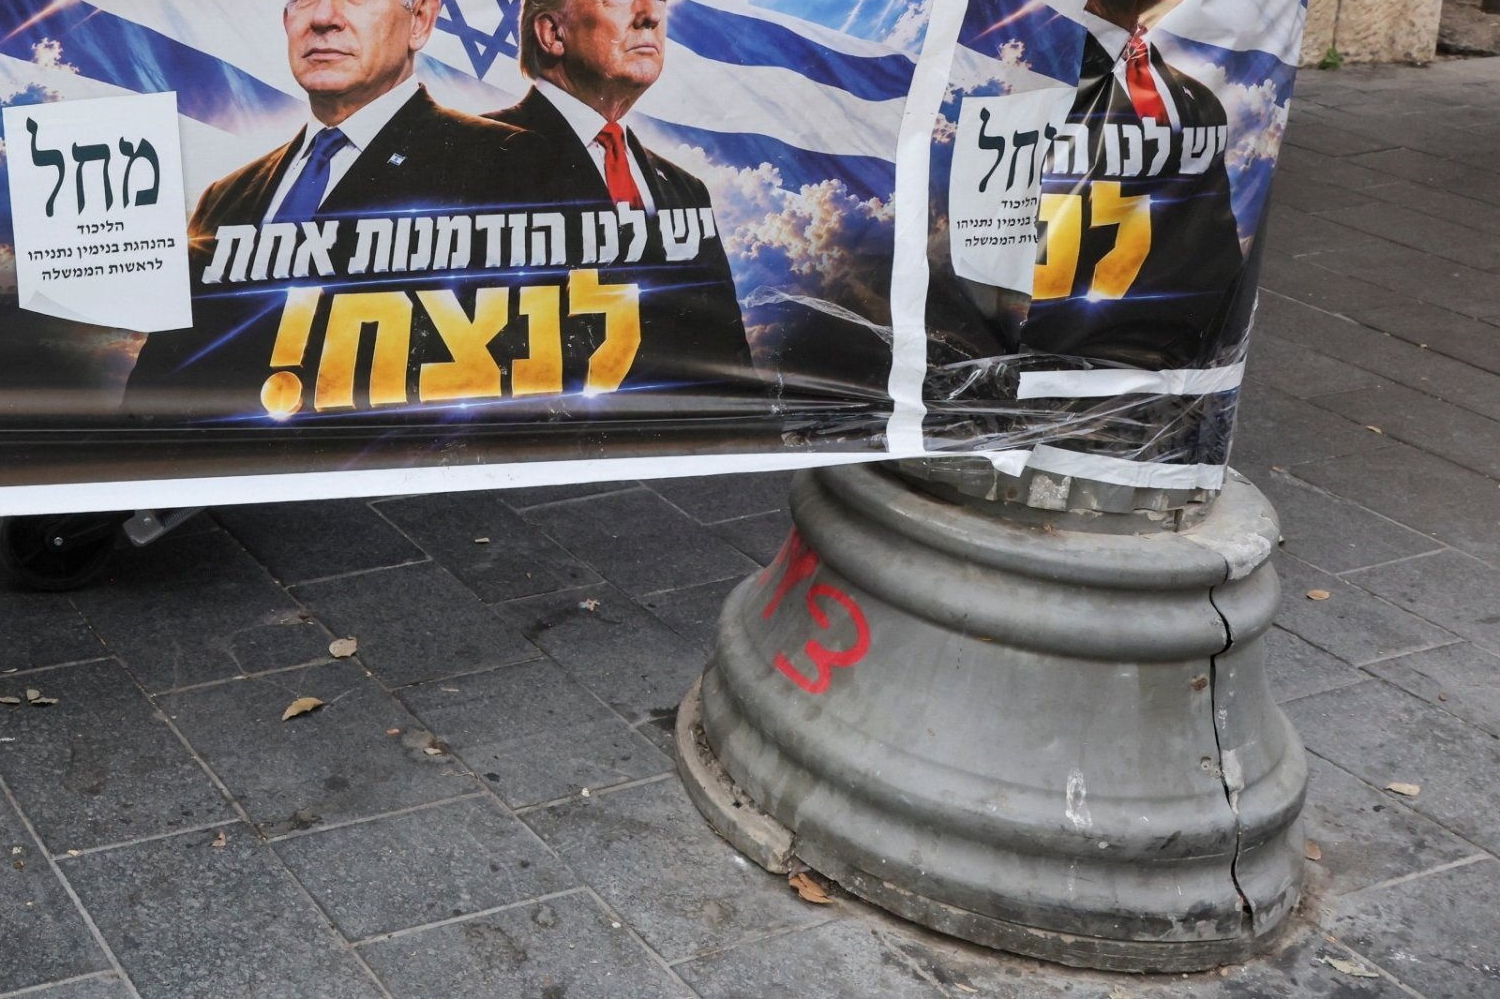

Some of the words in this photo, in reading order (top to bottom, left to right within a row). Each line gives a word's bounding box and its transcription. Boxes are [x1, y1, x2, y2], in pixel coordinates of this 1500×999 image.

[1104, 117, 1171, 177] לנו
[1179, 125, 1228, 175] יש
[26, 117, 160, 218] מחל
[1001, 197, 1037, 209] הליכוד
[77, 220, 125, 235] הליכוד
[956, 217, 992, 230] נתניהו
[997, 216, 1031, 230] בנימין
[581, 201, 648, 264] לנו
[659, 206, 717, 262] יש
[123, 237, 176, 252] בהנהגת
[348, 212, 566, 275] הזדמנות
[965, 234, 1015, 248] הממשלה
[28, 247, 72, 262] נתניהו
[77, 243, 119, 259] בנימין
[202, 220, 339, 284] אחת
[42, 265, 104, 282] הממשלה
[108, 258, 163, 274] לראשות
[261, 269, 642, 419] לנצח!
